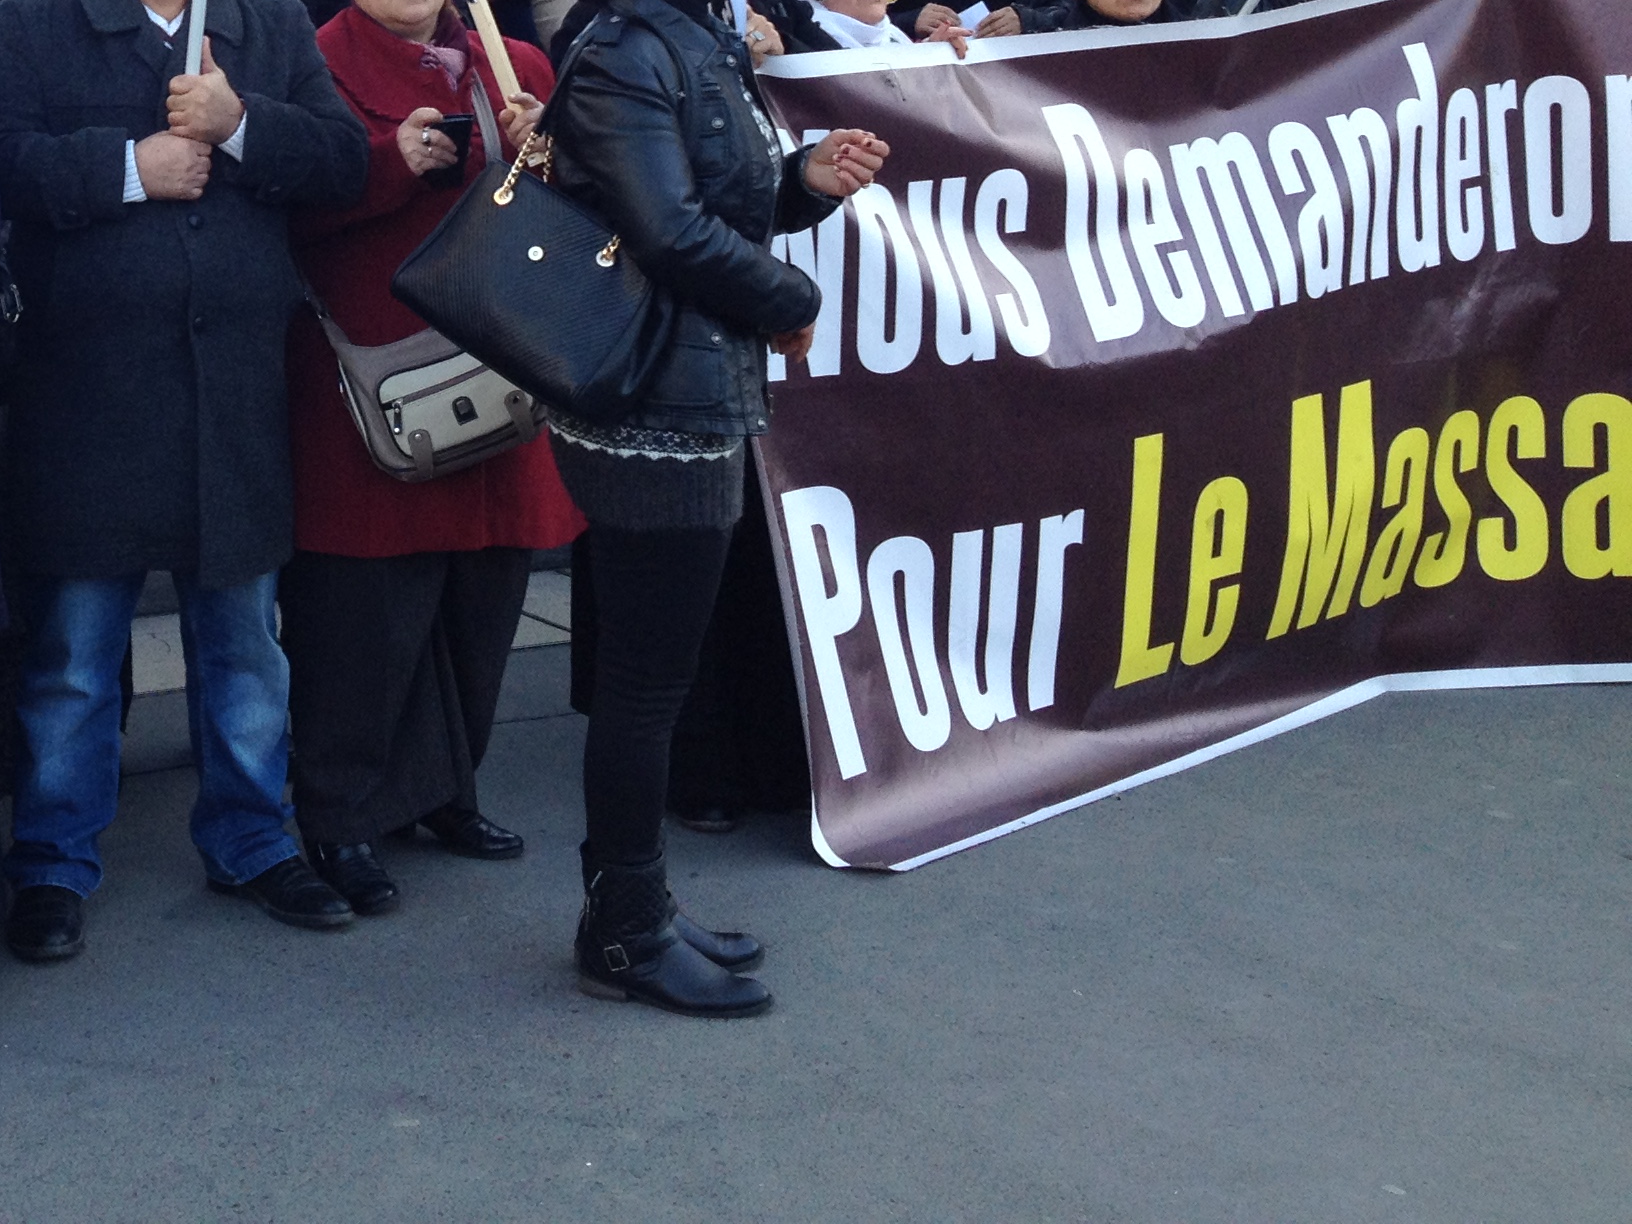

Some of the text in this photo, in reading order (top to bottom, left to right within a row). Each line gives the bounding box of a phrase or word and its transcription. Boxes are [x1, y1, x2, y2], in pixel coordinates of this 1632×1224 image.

[781, 379, 1632, 780] Pour Le Massa
